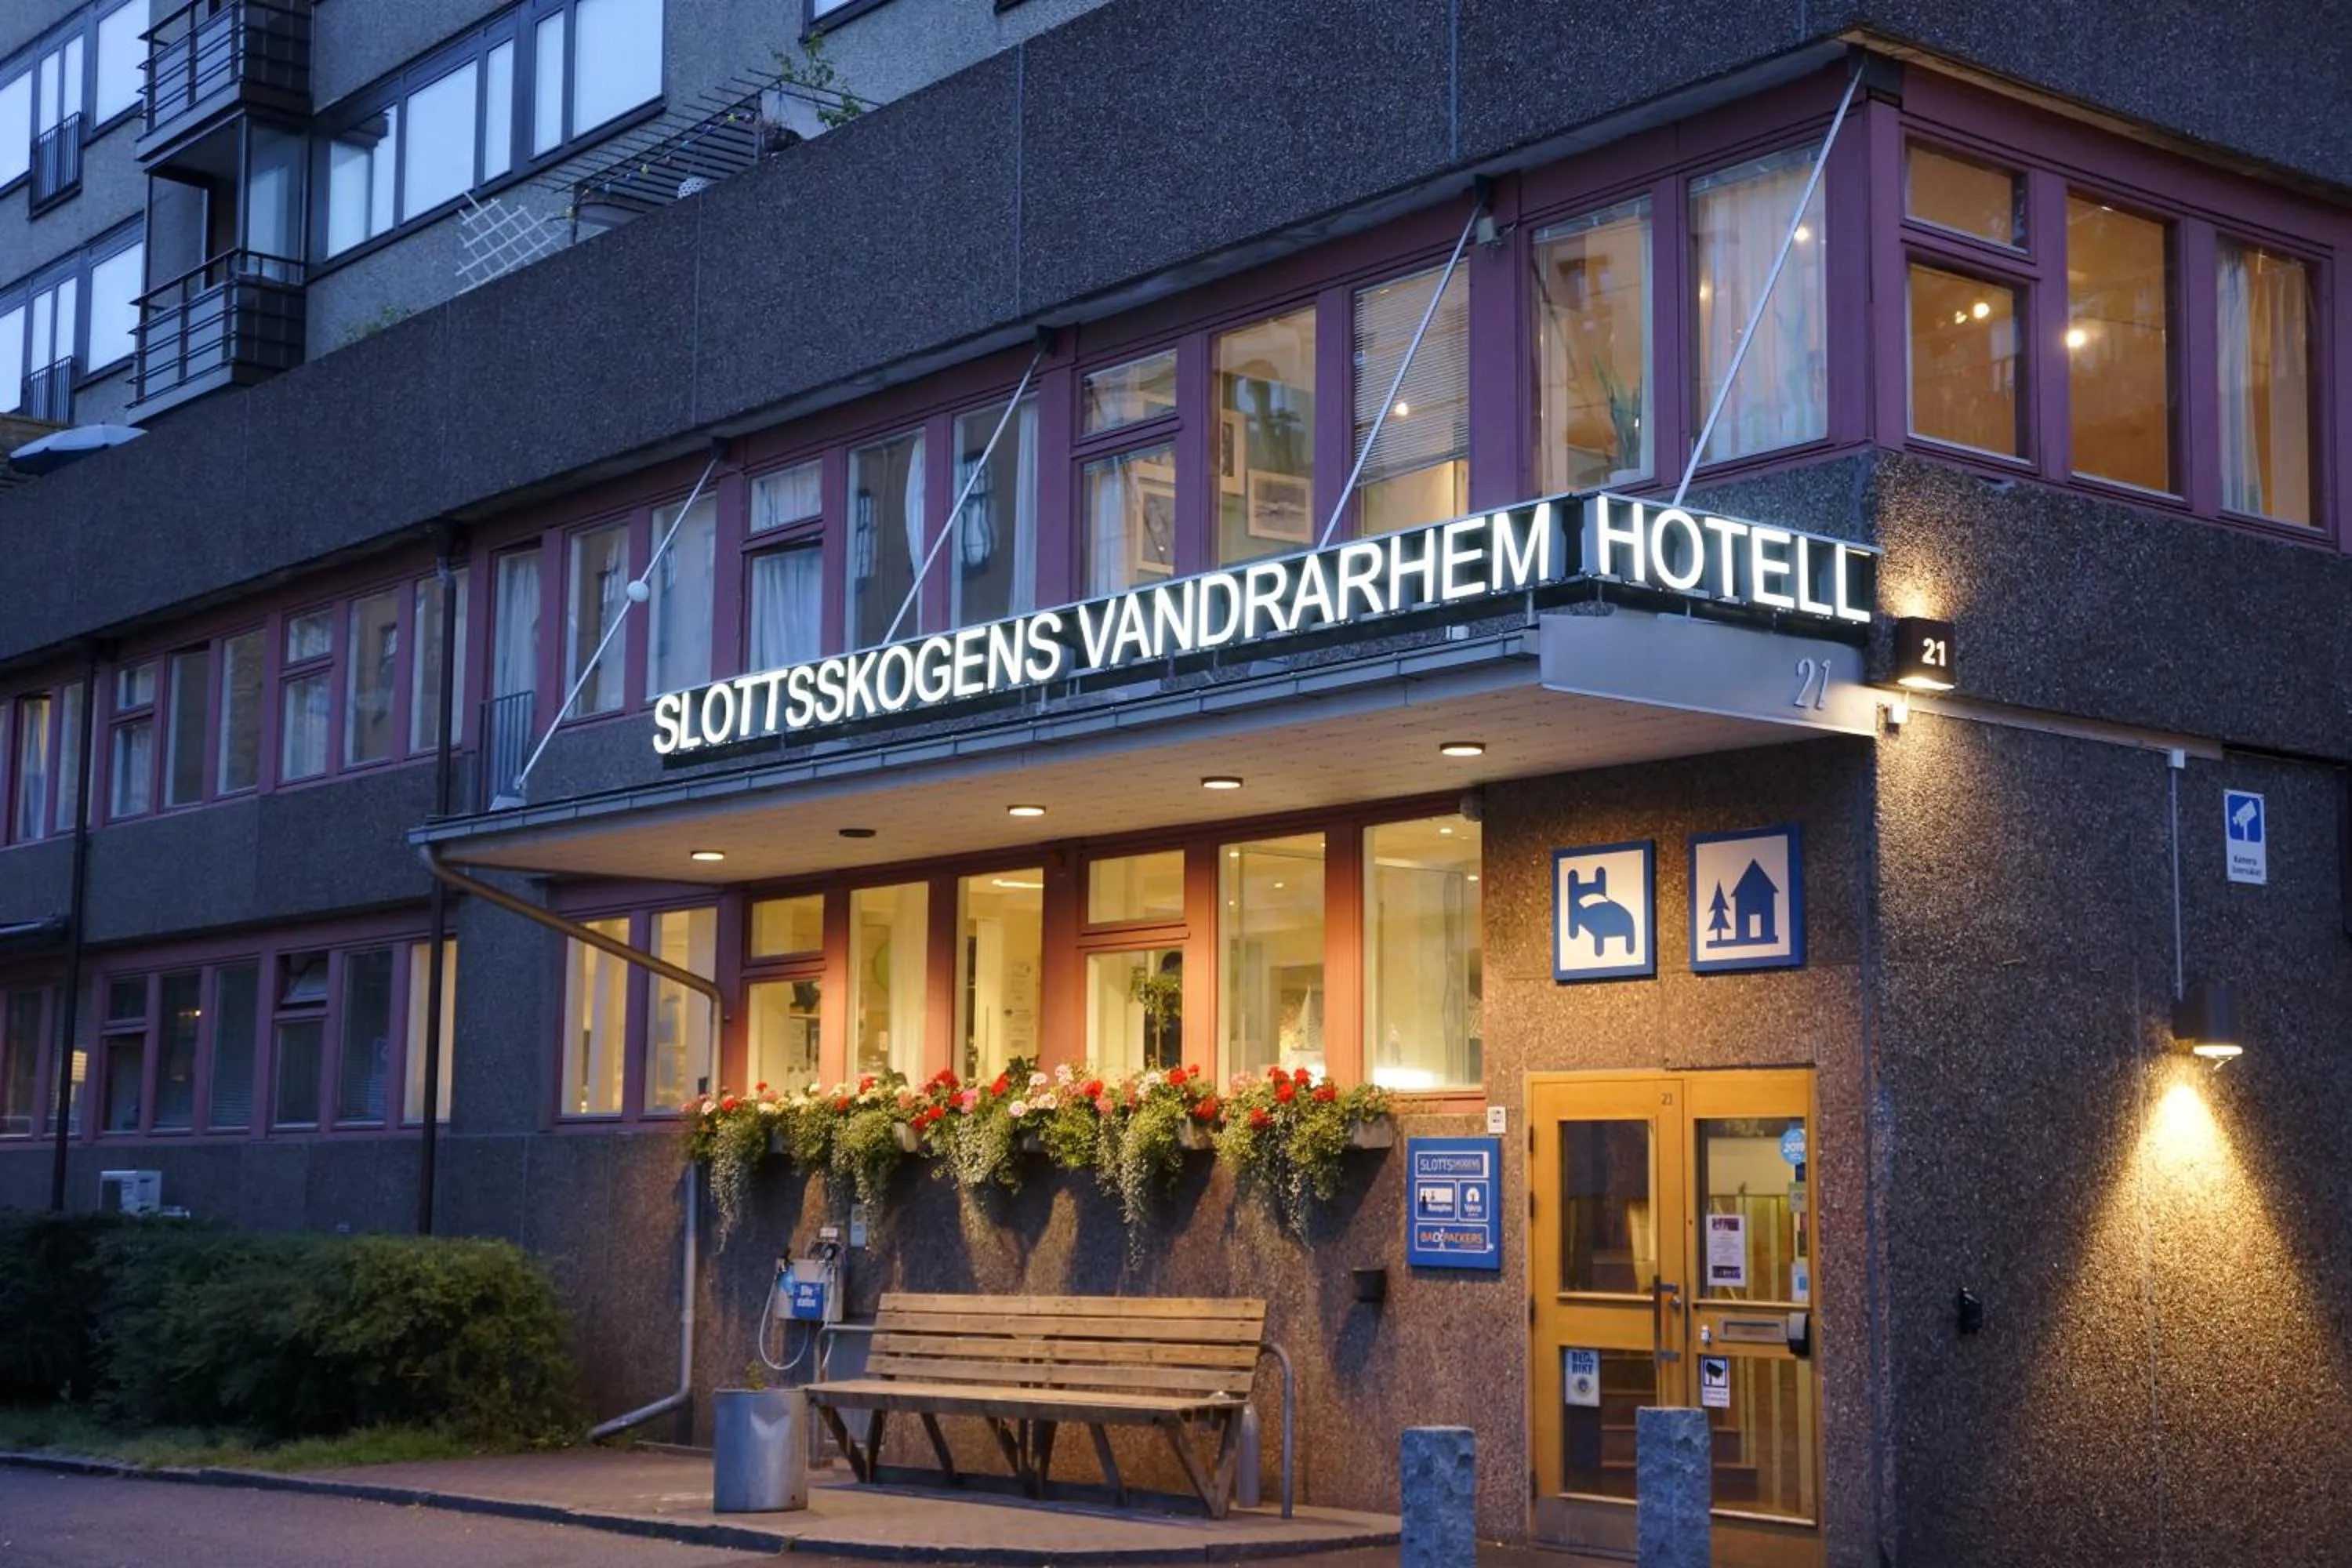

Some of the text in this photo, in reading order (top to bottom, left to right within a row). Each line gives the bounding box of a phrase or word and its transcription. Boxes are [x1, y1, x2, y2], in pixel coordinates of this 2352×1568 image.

[652, 495, 1871, 755] SLOTTSSKOGENS VANDRARHEM HOTELL
[1922, 637, 1947, 666] 21
[1794, 658, 1831, 710] 21
